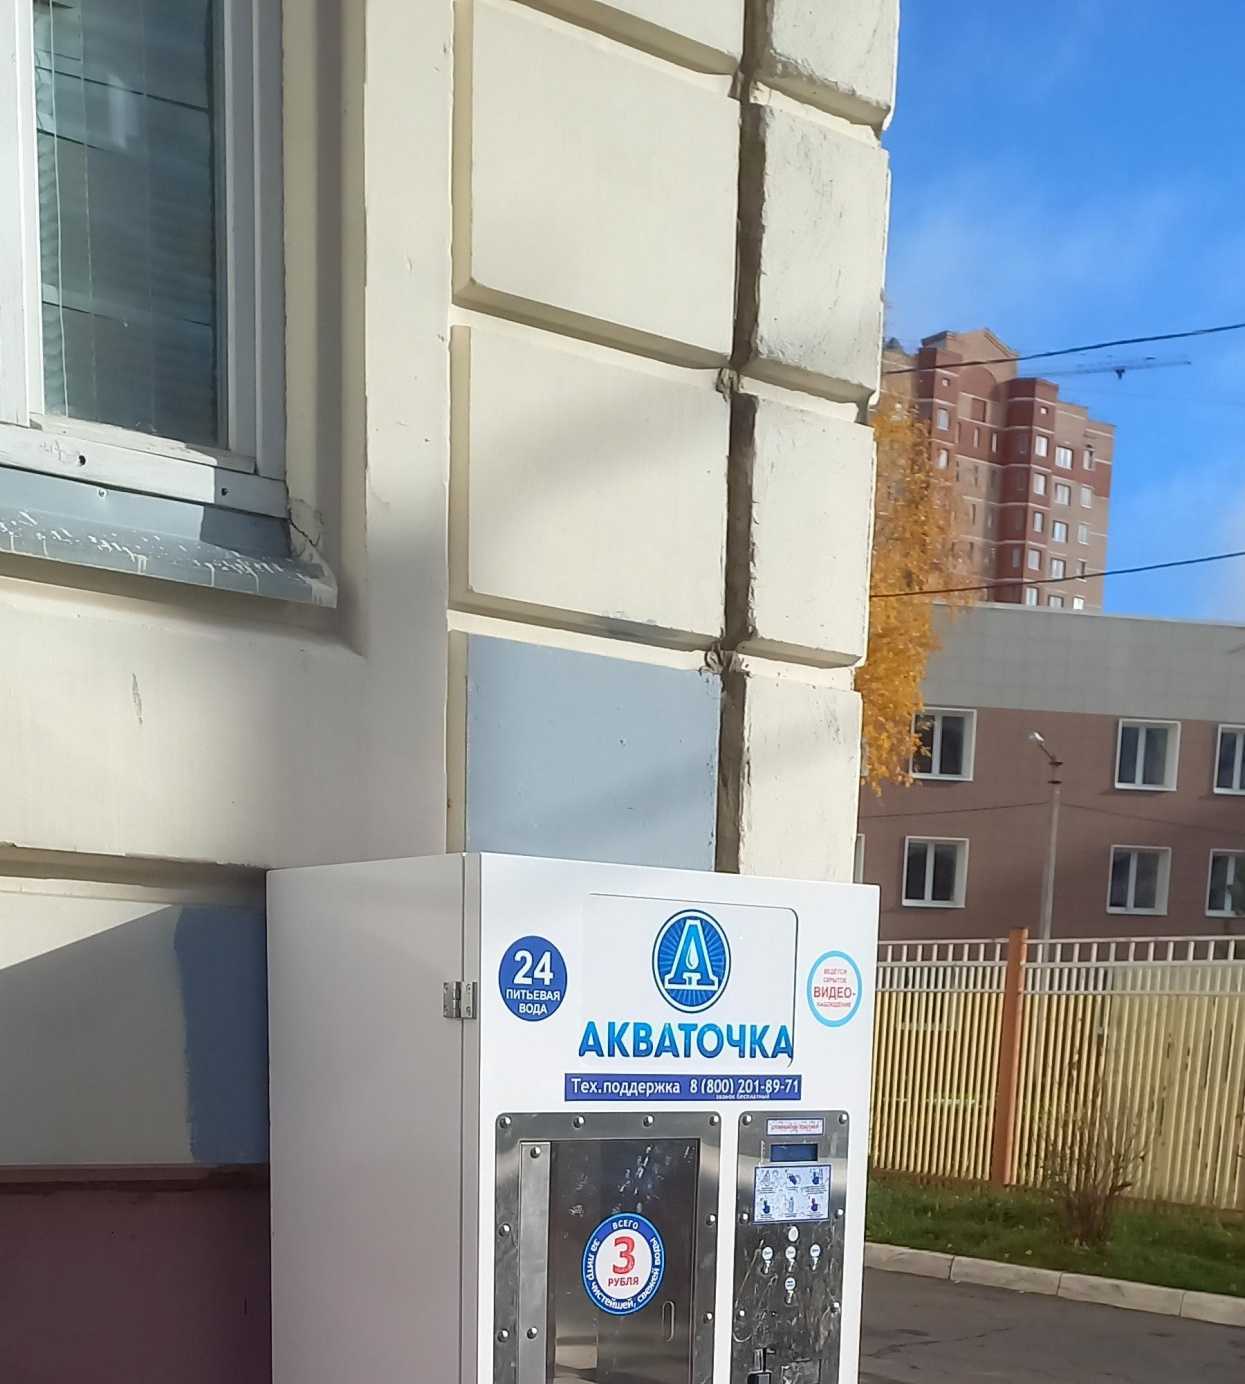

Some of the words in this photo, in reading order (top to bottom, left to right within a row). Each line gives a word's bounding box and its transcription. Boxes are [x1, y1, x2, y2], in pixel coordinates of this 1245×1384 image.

[513, 949, 554, 986] 24
[506, 988, 561, 1001] ПИТЬЕВАЯ
[813, 986, 857, 1000] ВИДЕО-
[519, 1003, 548, 1016] ВОДА
[578, 1020, 794, 1060] АКВАТОЧКА
[571, 1077, 681, 1097] Тех.поддержка
[689, 1078, 698, 1094] 8
[700, 1078, 734, 1095] (800)
[737, 1078, 799, 1095] 201-89-71
[612, 1235, 636, 1275] 3
[607, 1276, 640, 1287] РУБЛЯ
